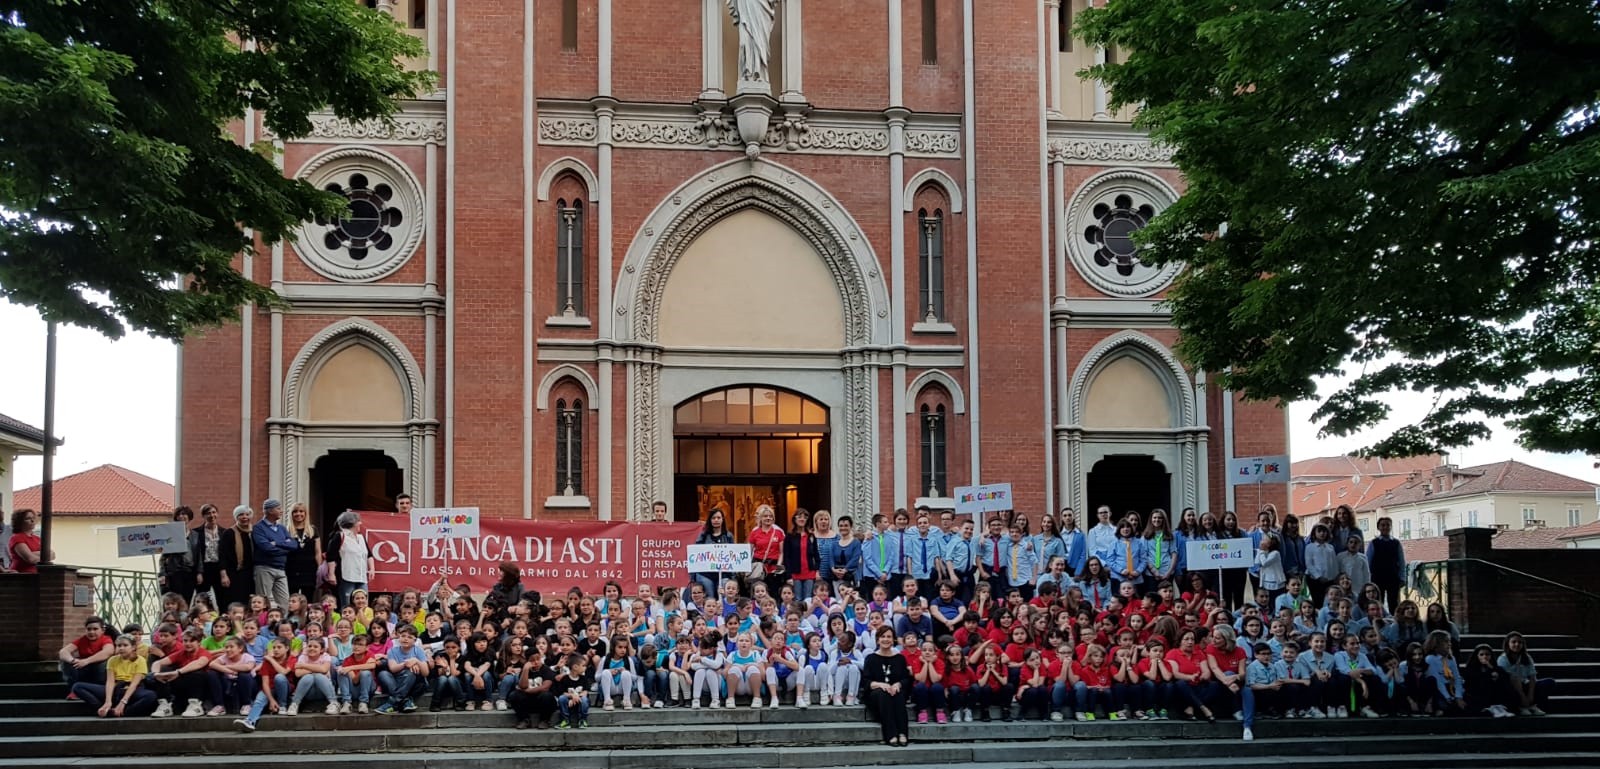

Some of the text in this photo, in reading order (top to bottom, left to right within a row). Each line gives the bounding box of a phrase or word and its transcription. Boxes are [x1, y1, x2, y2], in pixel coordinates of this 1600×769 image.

[1254, 463, 1262, 474] 7
[641, 539, 681, 548] GRUPPO
[420, 535, 623, 564] BANCA DI ASTI
[641, 550, 673, 558] CASSA
[641, 560, 689, 568] DI RISPAR
[420, 565, 623, 579] CASSA DI RARMIO DAL 1842
[641, 570, 675, 579] DI ASTI
